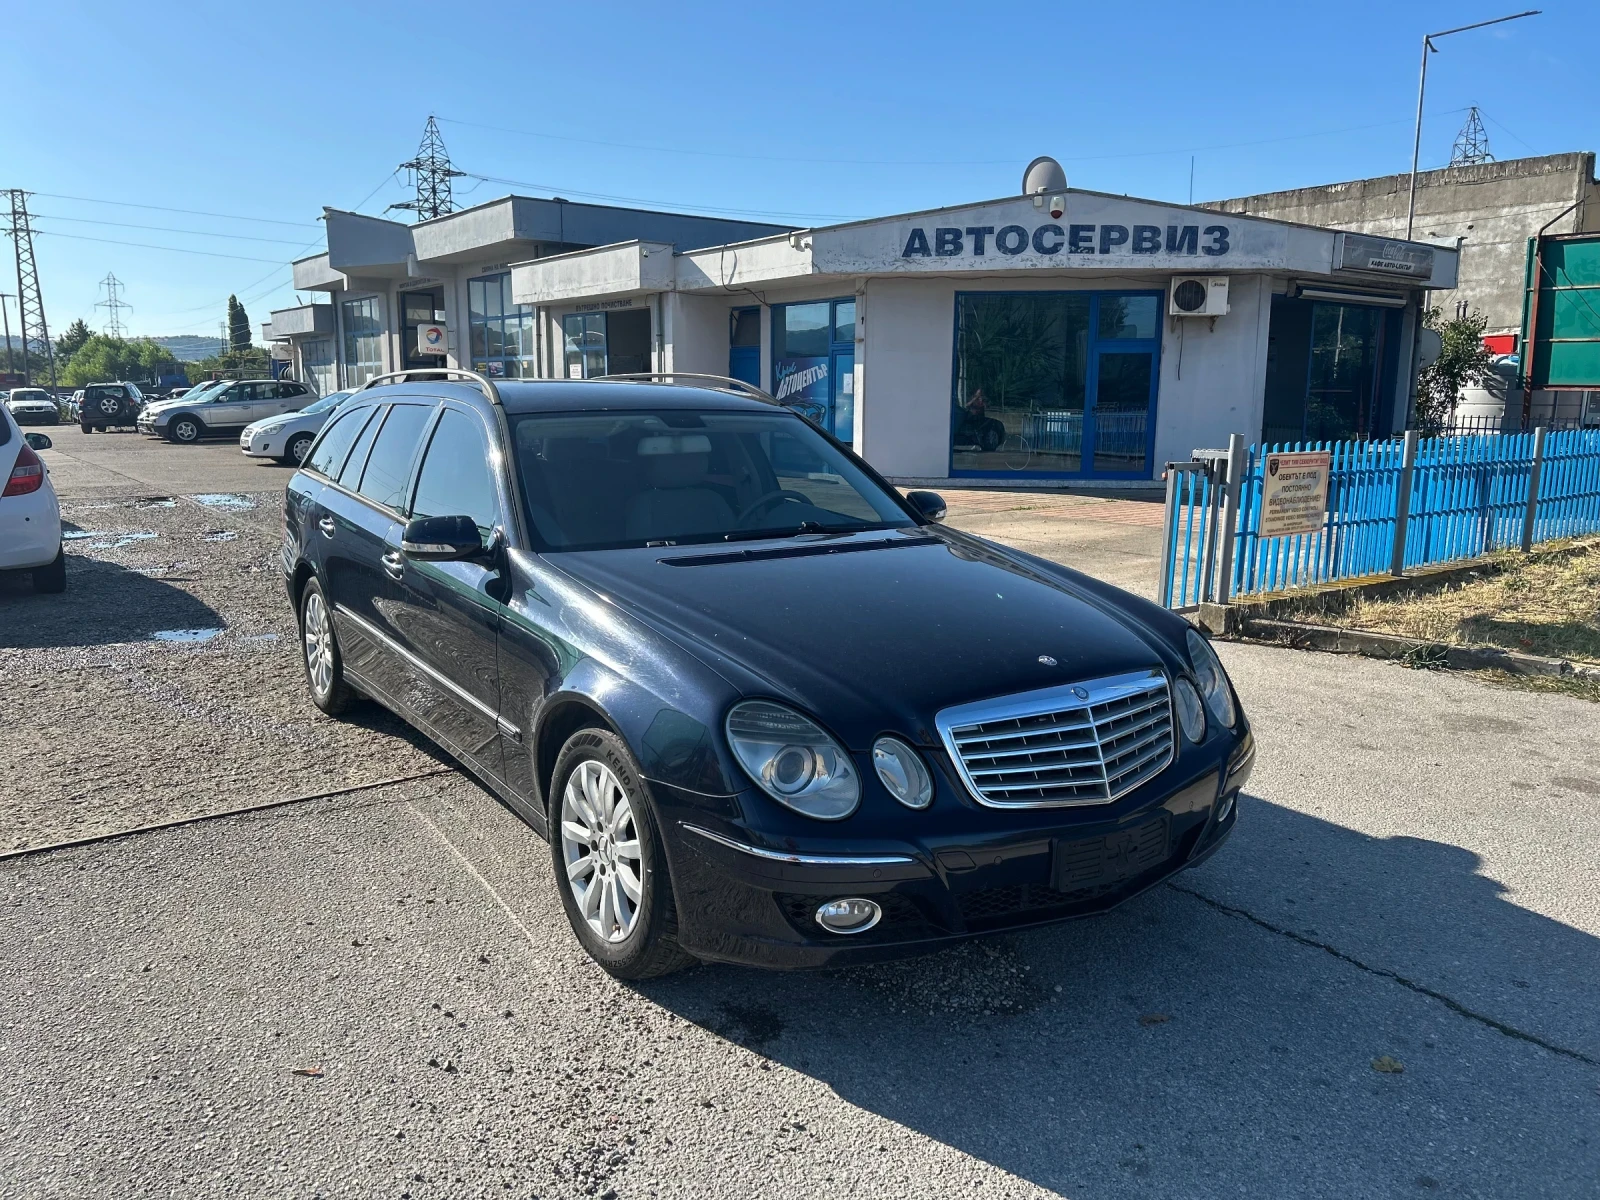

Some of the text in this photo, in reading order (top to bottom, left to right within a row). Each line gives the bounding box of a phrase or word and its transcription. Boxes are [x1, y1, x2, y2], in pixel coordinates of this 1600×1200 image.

[902, 224, 1231, 258] АВТОСЕРВИЗ
[1278, 472, 1302, 480] ОБЕКТЪТ
[1306, 472, 1316, 480] ПОД
[1282, 484, 1312, 493] ПОСТОЯННО
[606, 749, 636, 798] KENDA
